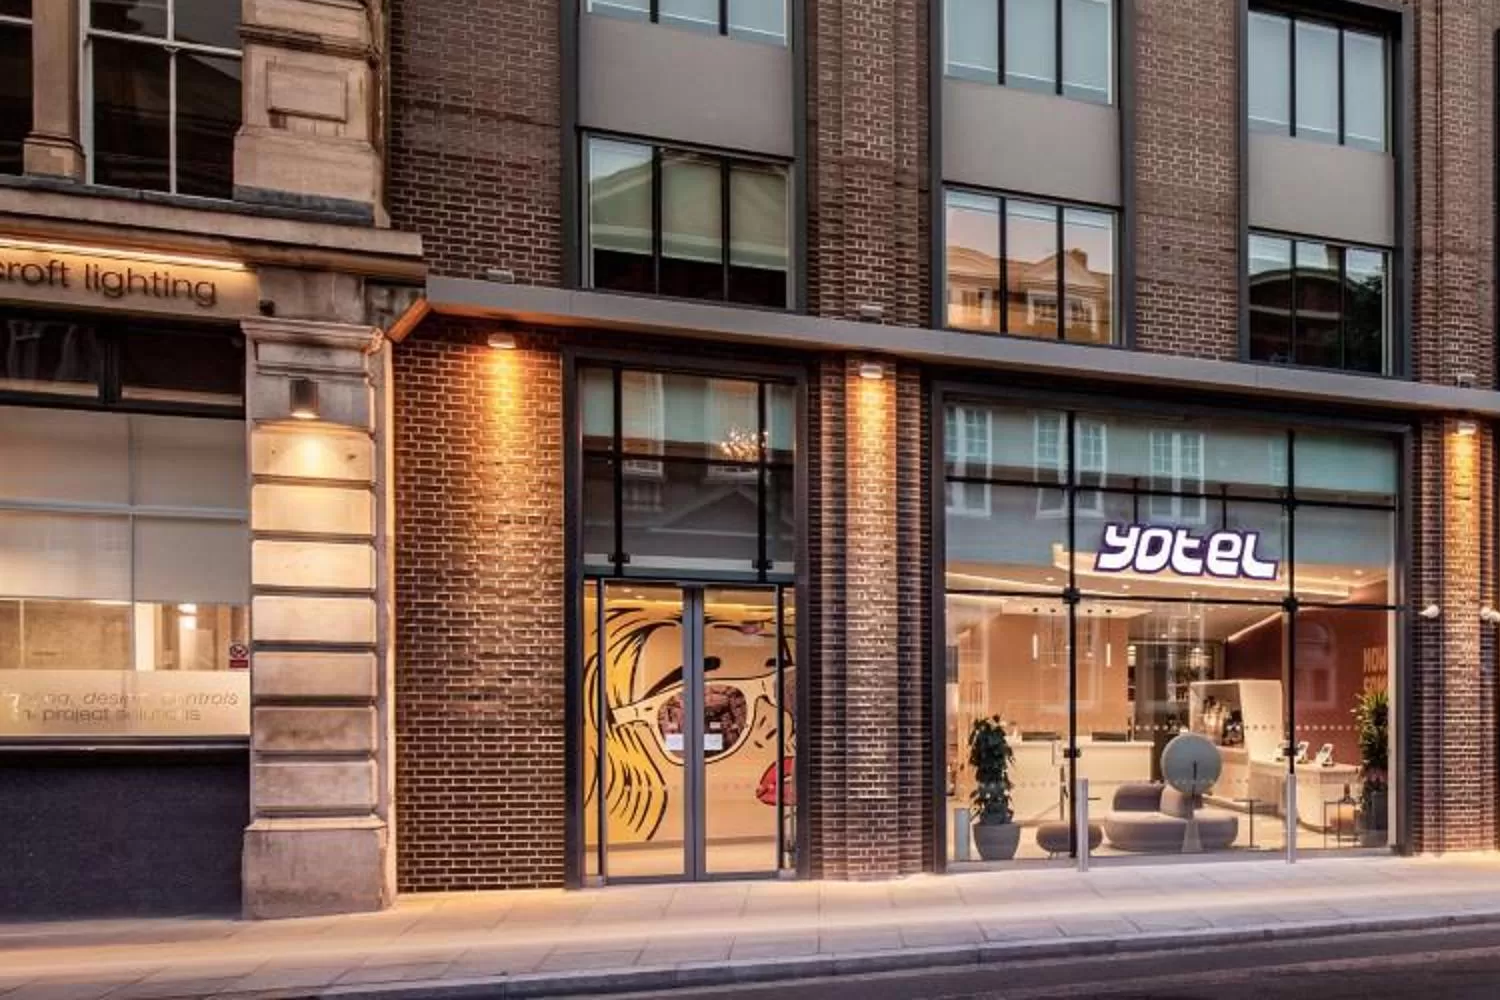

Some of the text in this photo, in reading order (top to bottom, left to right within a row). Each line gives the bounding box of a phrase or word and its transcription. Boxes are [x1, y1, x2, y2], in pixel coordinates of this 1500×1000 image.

[0, 258, 218, 307] roft lighting
[42, 707, 108, 722] project
